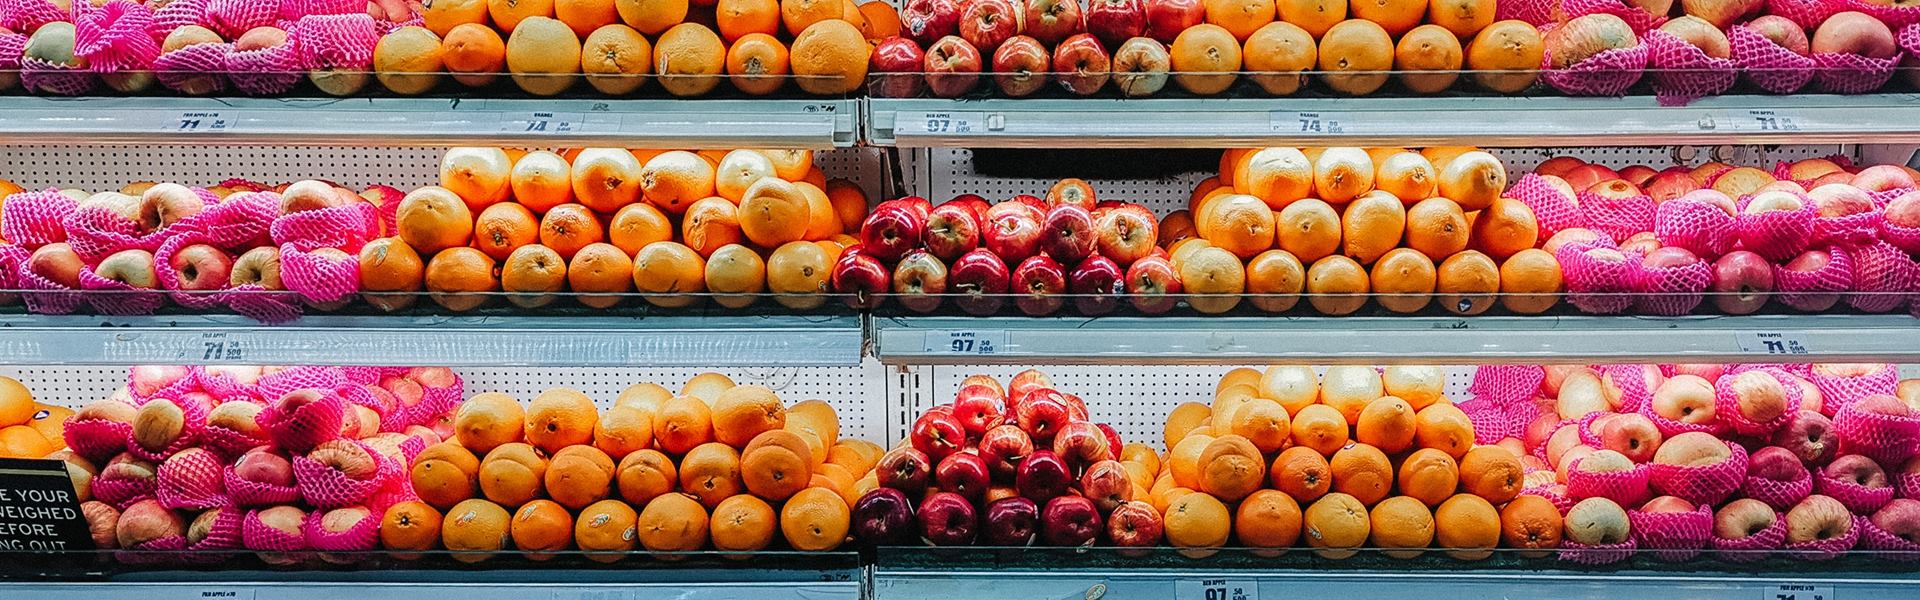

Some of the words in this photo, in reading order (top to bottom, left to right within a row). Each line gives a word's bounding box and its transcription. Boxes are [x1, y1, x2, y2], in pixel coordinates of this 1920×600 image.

[180, 119, 200, 129] 71
[927, 119, 950, 132] 97
[1299, 119, 1321, 132] 74
[1756, 117, 1779, 130] 71
[203, 342, 224, 360] 71
[227, 348, 242, 356] 500
[951, 339, 974, 352] 97
[1762, 340, 1786, 354] 71
[15, 489, 70, 503] YOUR
[29, 540, 66, 554] OUT
[1205, 588, 1226, 600] 97
